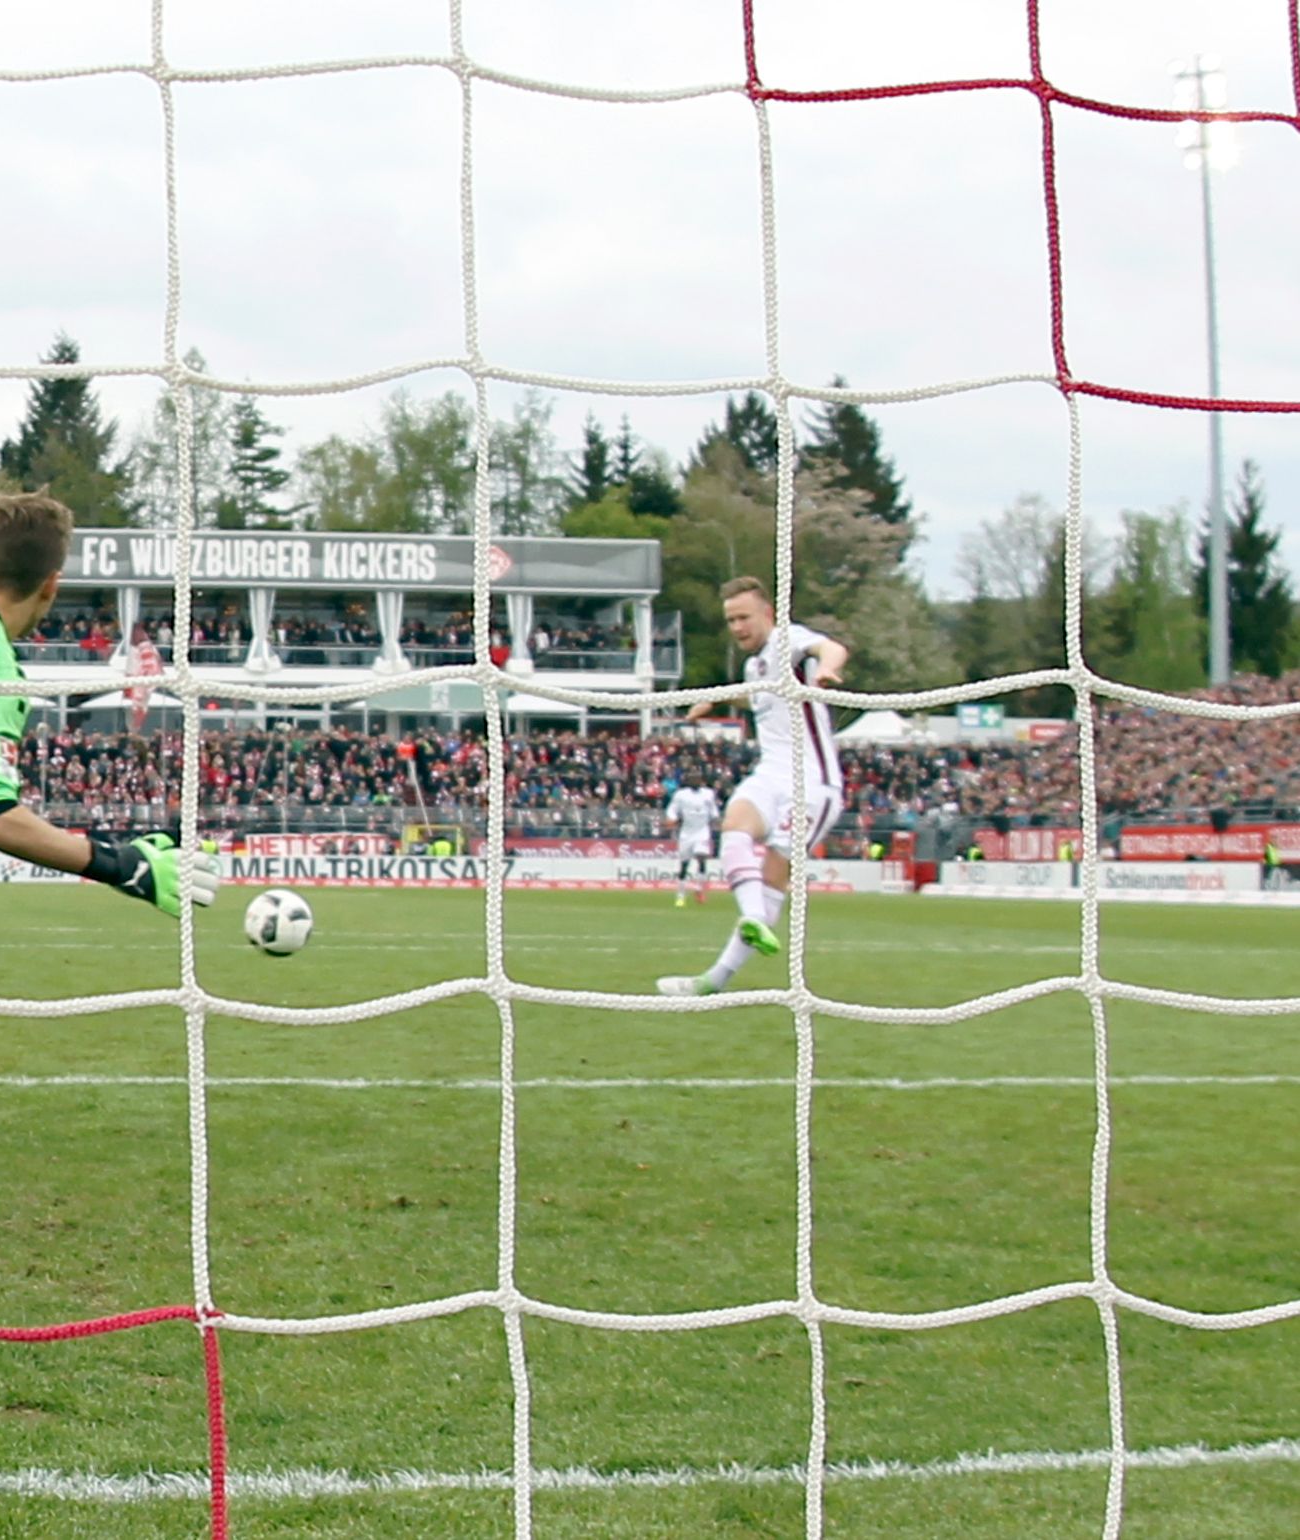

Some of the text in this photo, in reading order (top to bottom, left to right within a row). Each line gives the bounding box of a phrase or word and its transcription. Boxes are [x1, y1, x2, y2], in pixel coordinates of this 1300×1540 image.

[82, 533, 437, 581] FC WÜZBURGER KICKERS
